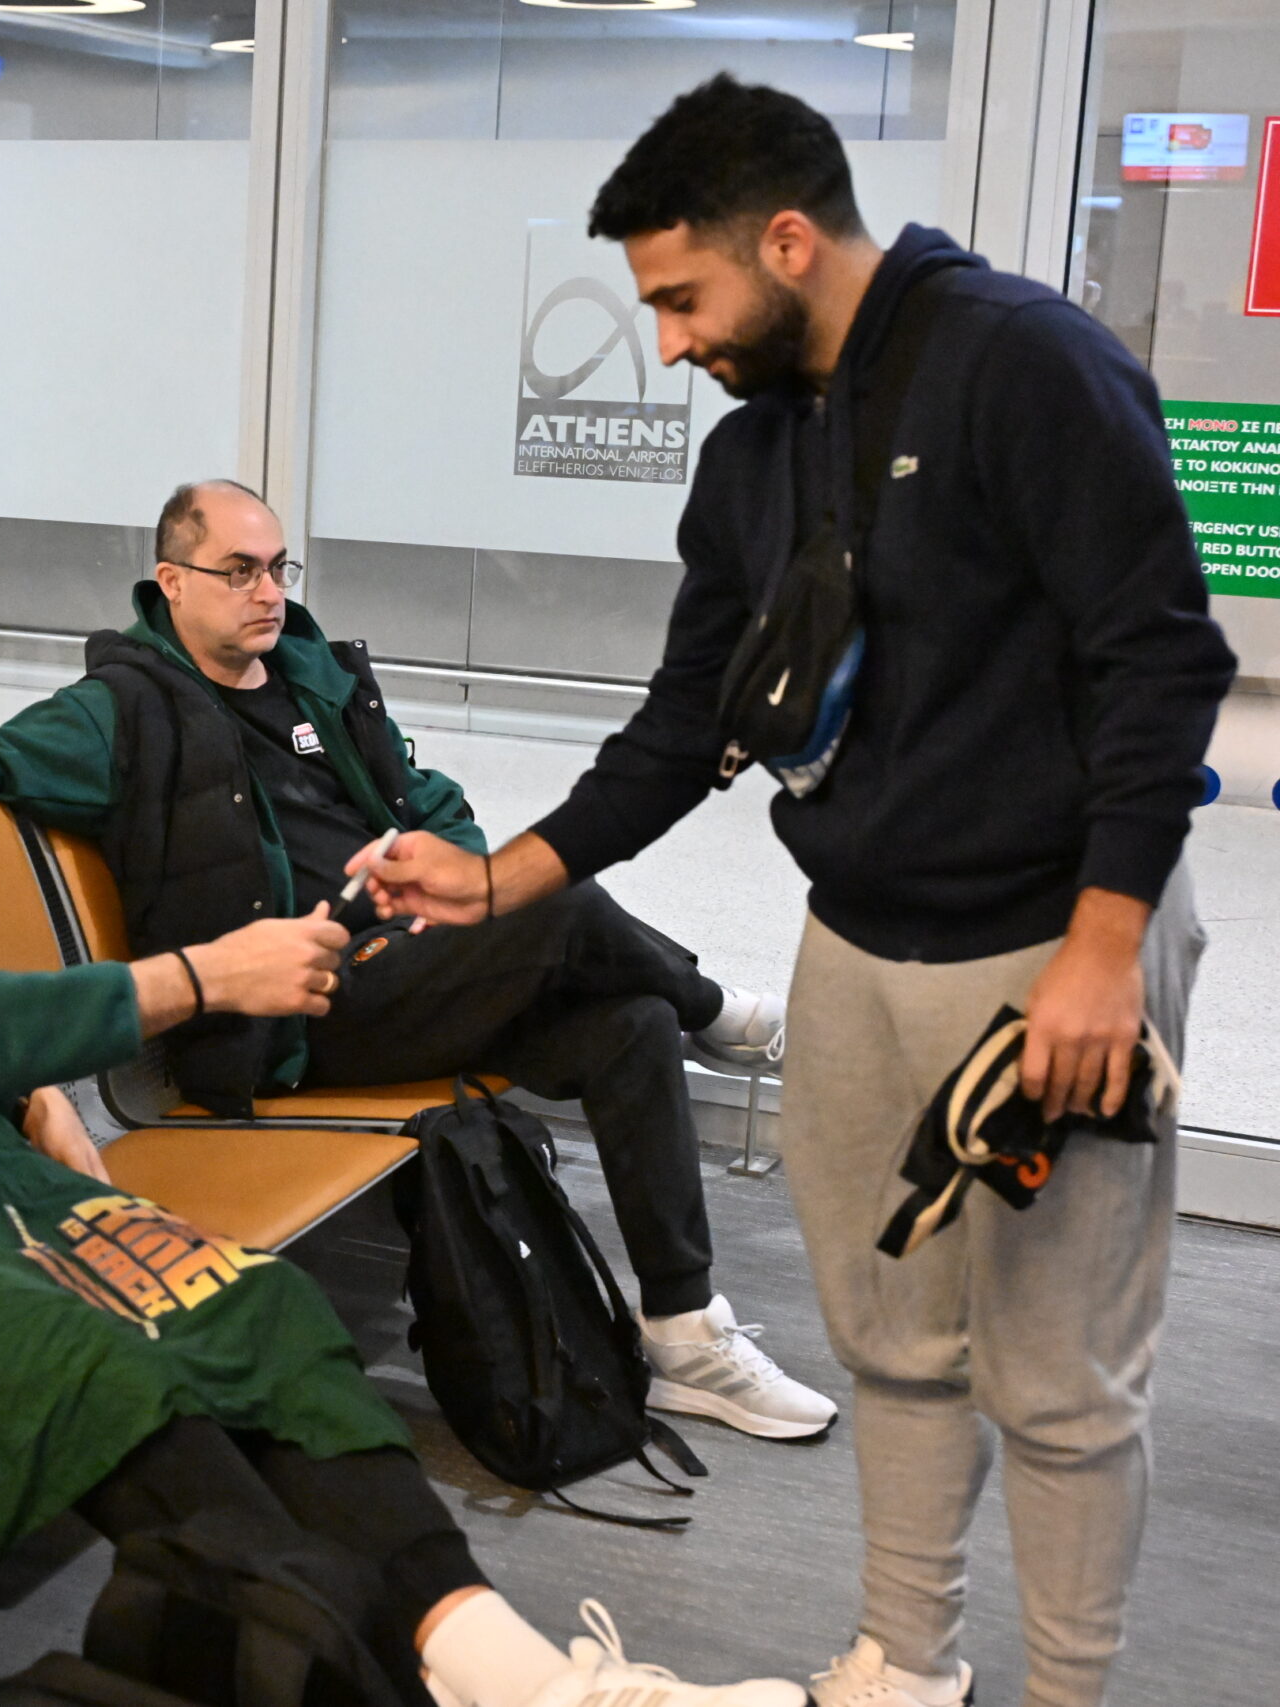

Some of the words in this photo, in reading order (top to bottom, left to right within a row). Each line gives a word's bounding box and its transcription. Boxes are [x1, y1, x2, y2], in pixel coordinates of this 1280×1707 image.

[519, 413, 686, 449] ATHENS
[1187, 418, 1238, 432] ΜΟΝΟ
[1241, 421, 1260, 433] ΣΕ
[1168, 438, 1240, 452] ΚΤΑΚΤΟΥ
[519, 444, 623, 462] INTERNATIONAL
[626, 450, 684, 465] AIRPORT
[517, 460, 604, 476] ELEFTHERIOS
[609, 465, 683, 481] VENIZELOS
[1186, 459, 1206, 471] ΤΟ
[1241, 482, 1275, 495] ΤΗΝ
[1258, 525, 1280, 538] US
[1202, 542, 1232, 555] RED
[1200, 562, 1242, 576] OPEN
